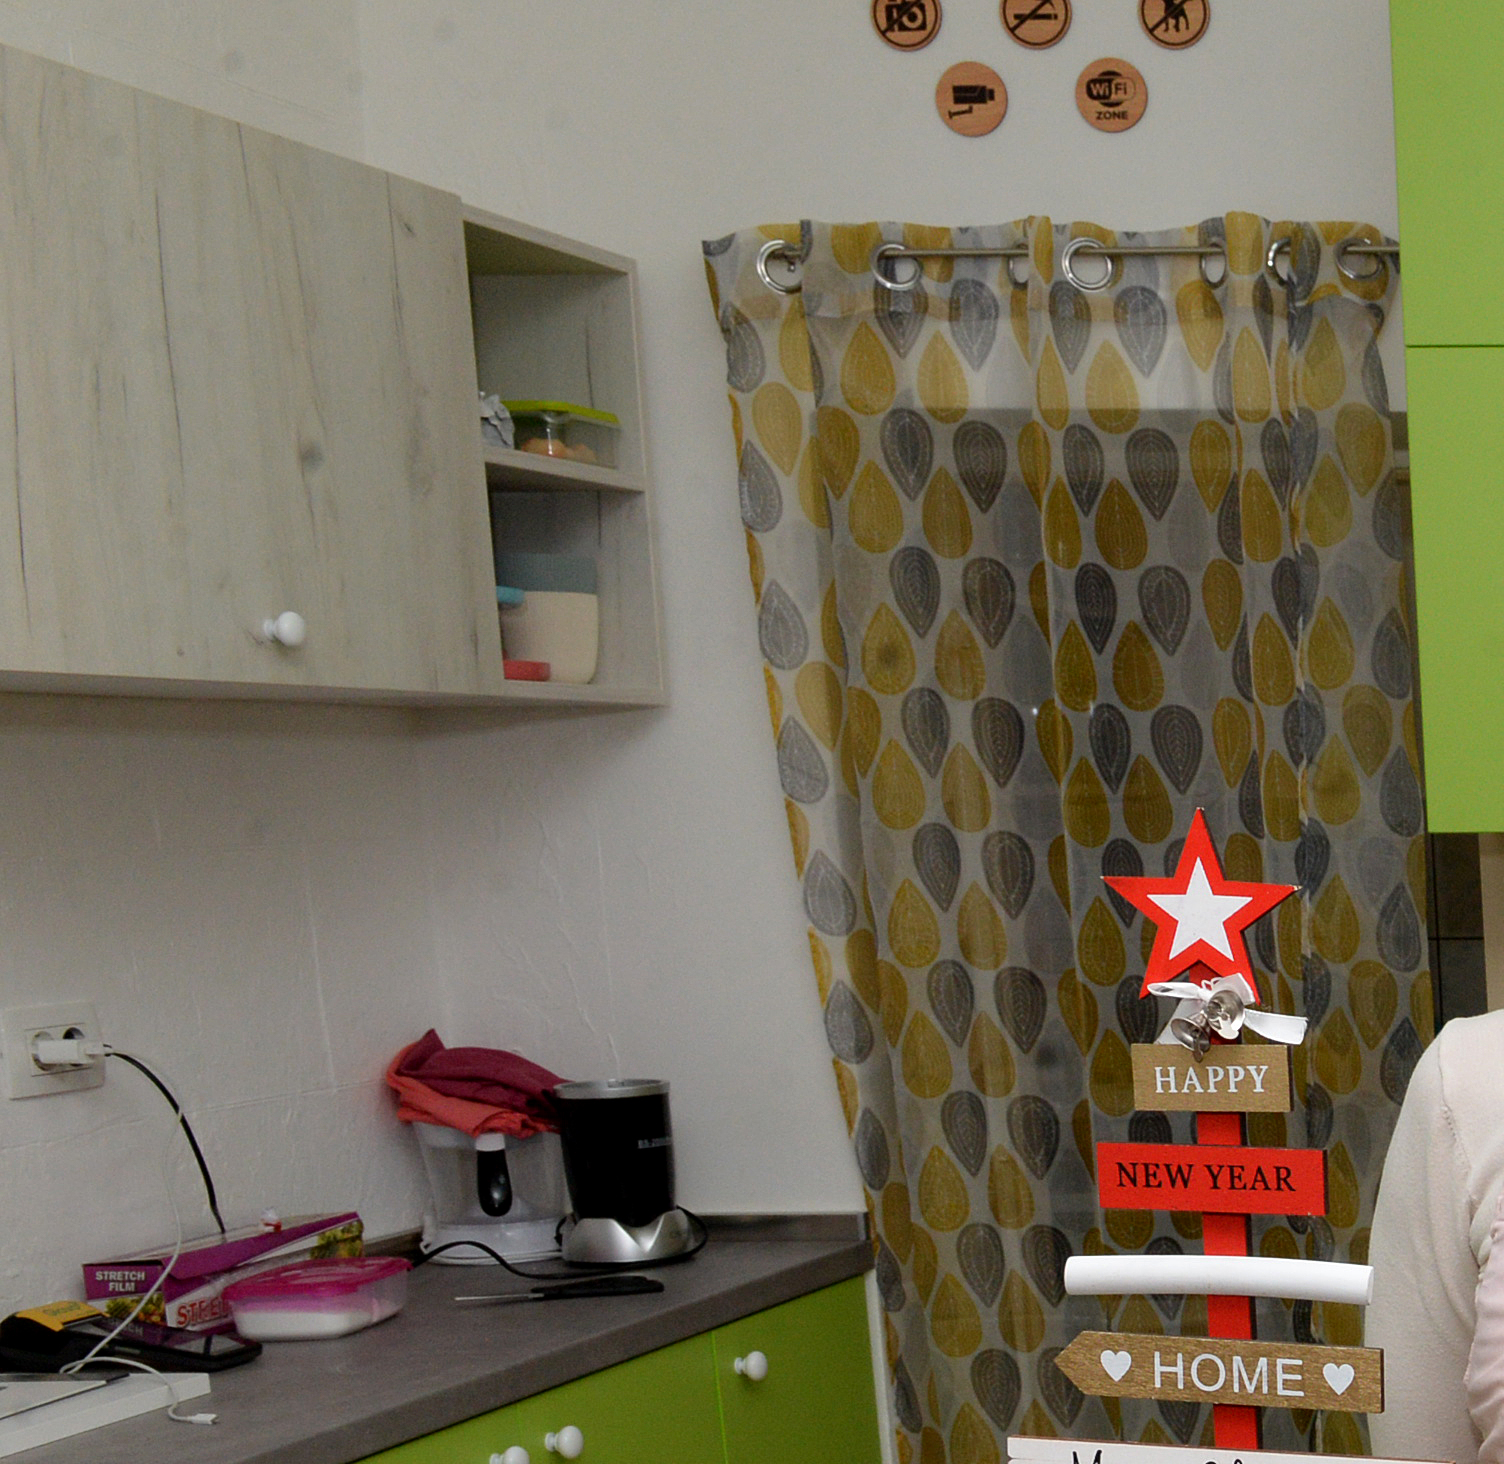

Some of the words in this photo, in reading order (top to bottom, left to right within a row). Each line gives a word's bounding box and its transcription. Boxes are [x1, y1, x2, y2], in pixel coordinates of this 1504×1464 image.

[1096, 111, 1128, 120] ZONE
[1154, 1065, 1268, 1094] HAPPY
[1116, 1162, 1194, 1190] NEW
[1203, 1164, 1296, 1193] YEAR
[95, 1271, 146, 1281] STRETCH
[109, 1282, 135, 1291] FILM
[1154, 1352, 1304, 1397] HOME
